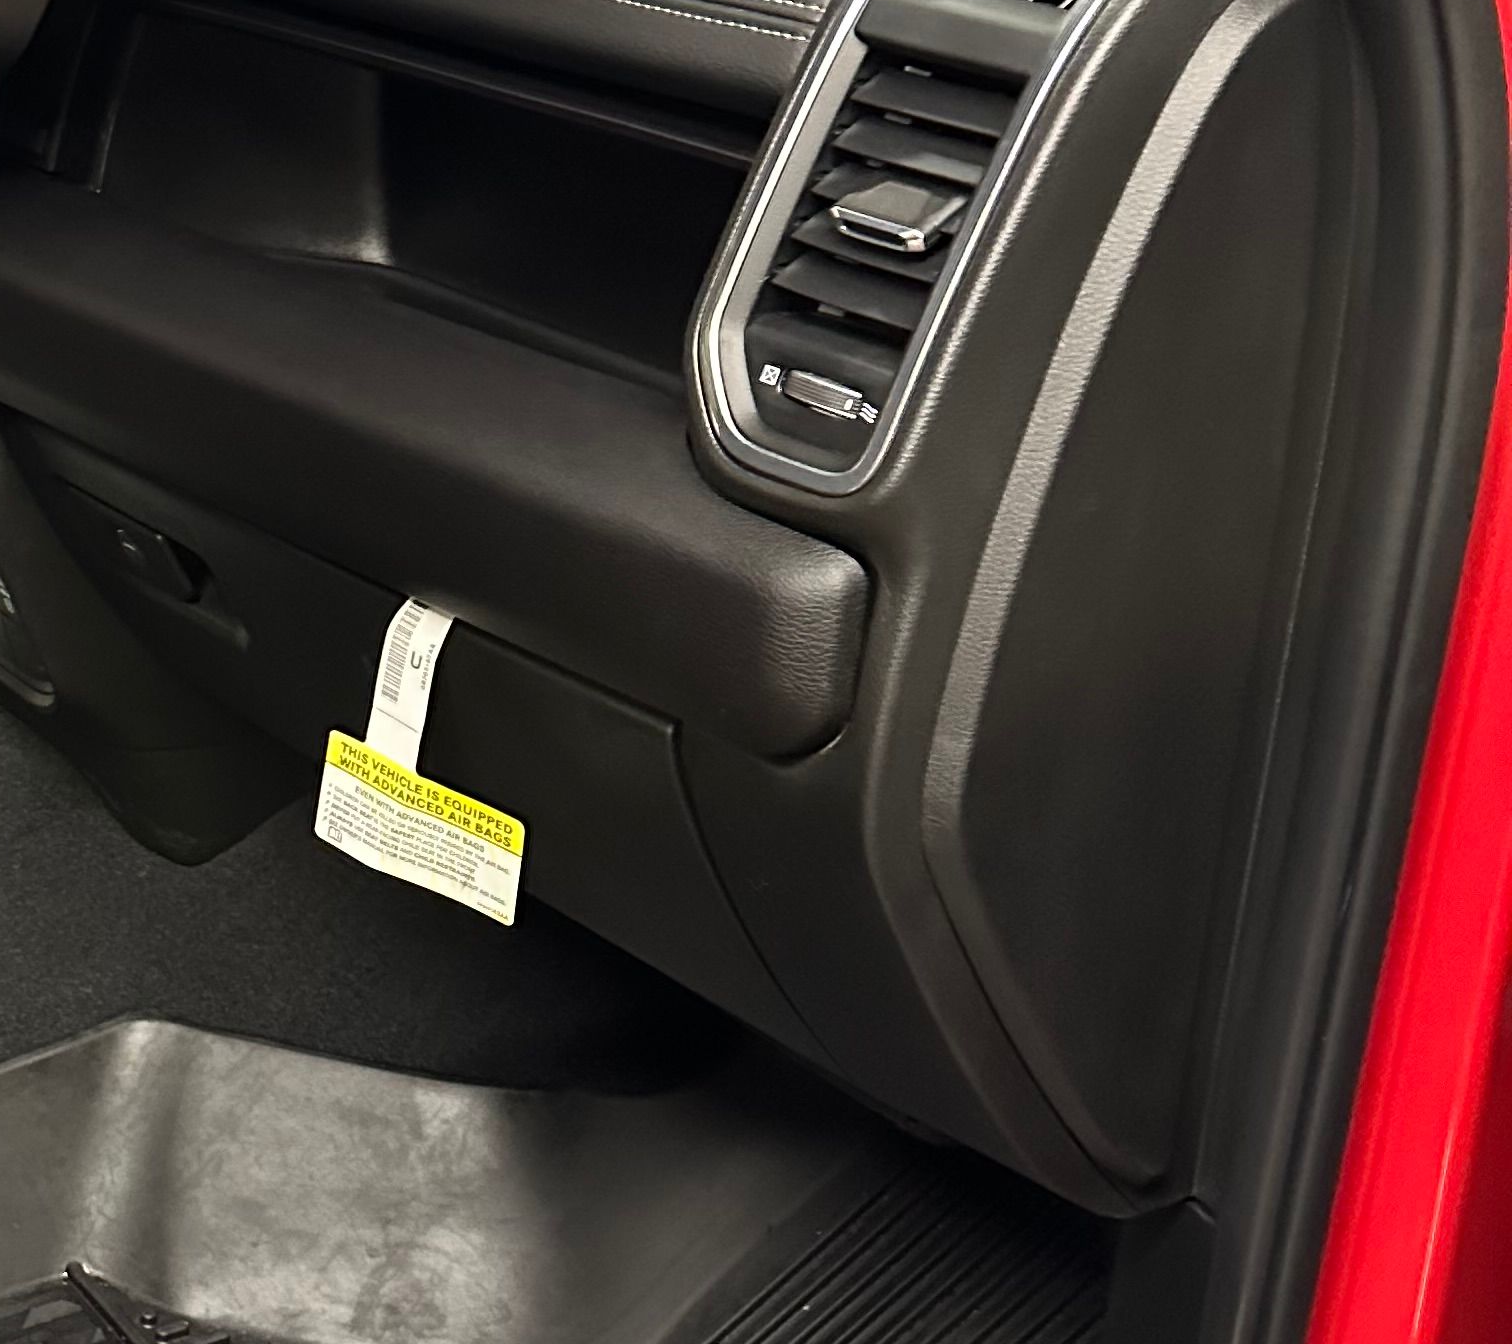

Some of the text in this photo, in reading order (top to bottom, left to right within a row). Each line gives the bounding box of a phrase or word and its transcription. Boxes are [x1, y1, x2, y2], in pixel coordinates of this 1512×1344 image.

[339, 754, 371, 780] WITH
[372, 775, 445, 816] ADVANCED
[448, 811, 471, 829] AIR
[475, 823, 512, 848] BAGS
[341, 741, 513, 835] THIS VEHICLE IS EQUIPPED
[354, 785, 375, 802] EVEN
[375, 797, 395, 814] WITH
[396, 810, 445, 834] ADVANCED
[446, 830, 461, 841] AIR
